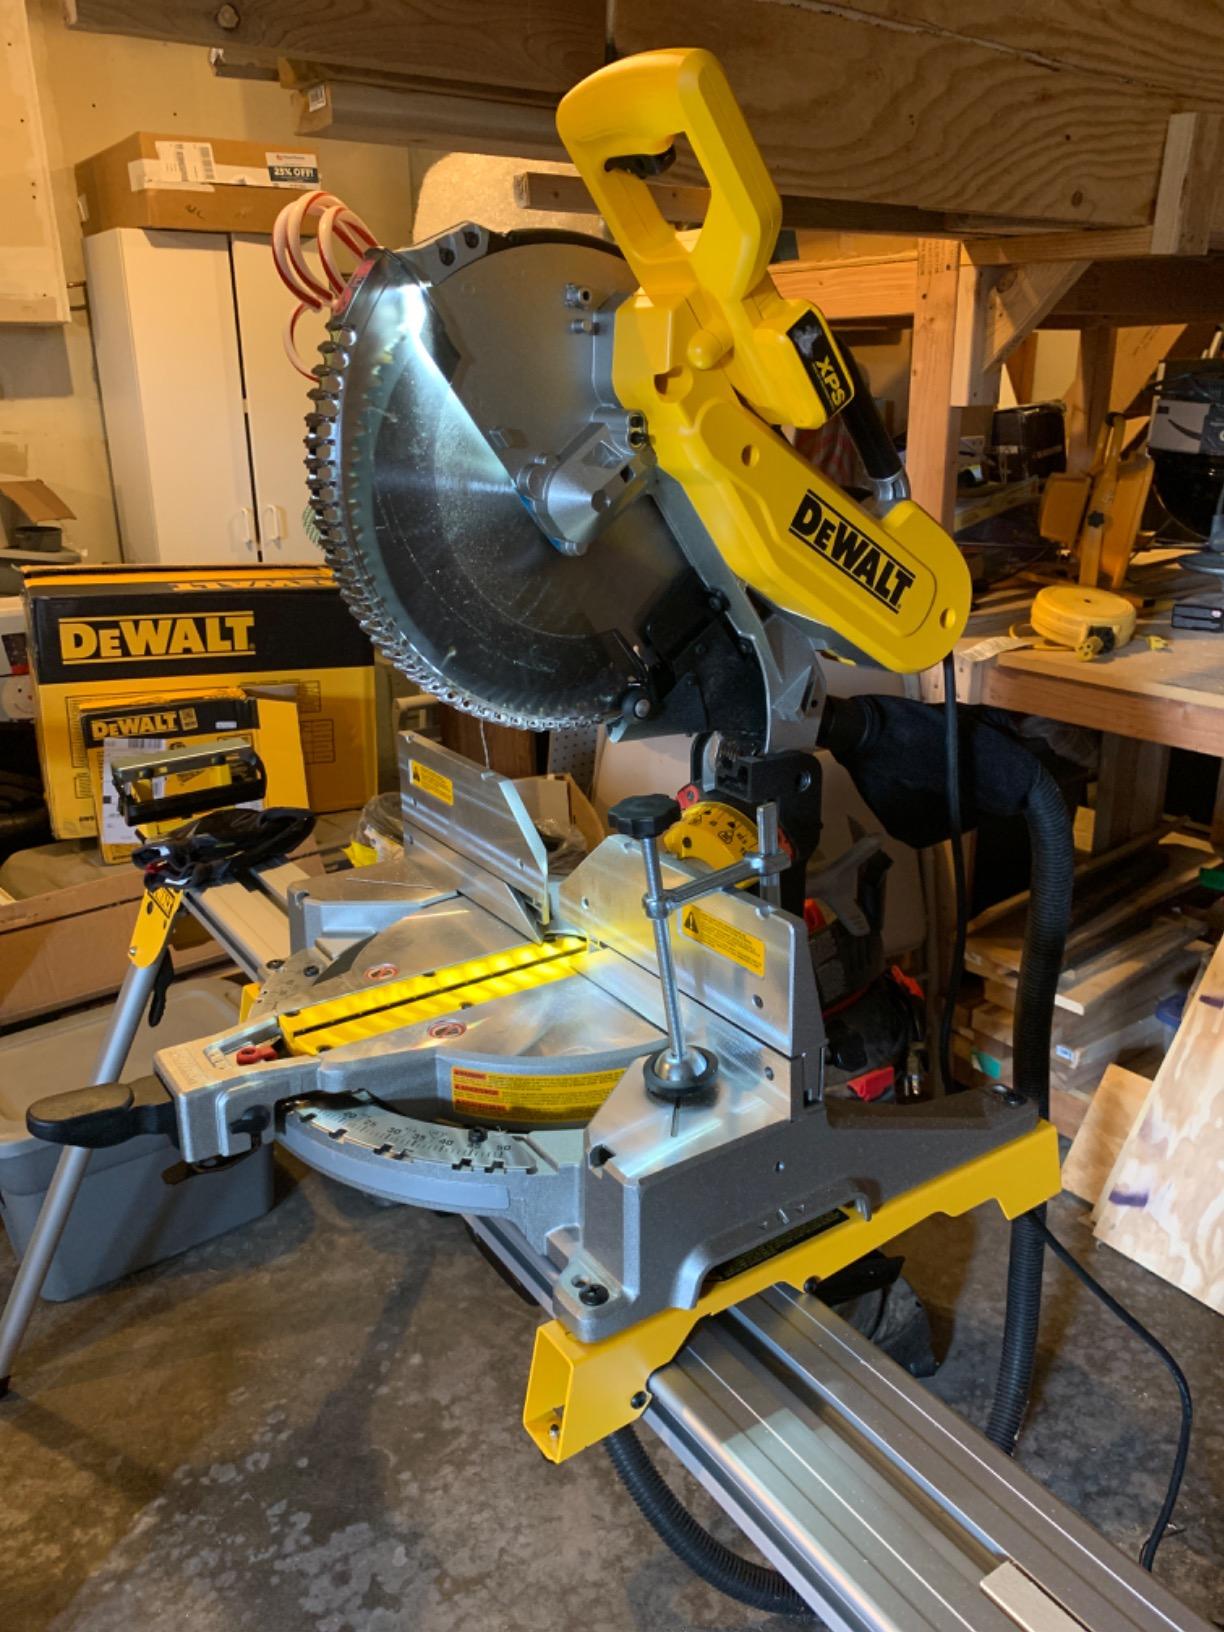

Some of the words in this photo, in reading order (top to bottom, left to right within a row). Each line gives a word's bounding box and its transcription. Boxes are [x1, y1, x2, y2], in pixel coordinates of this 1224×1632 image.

[273, 166, 292, 176] 25%
[293, 168, 314, 178] OFF!
[815, 355, 845, 406] XPS
